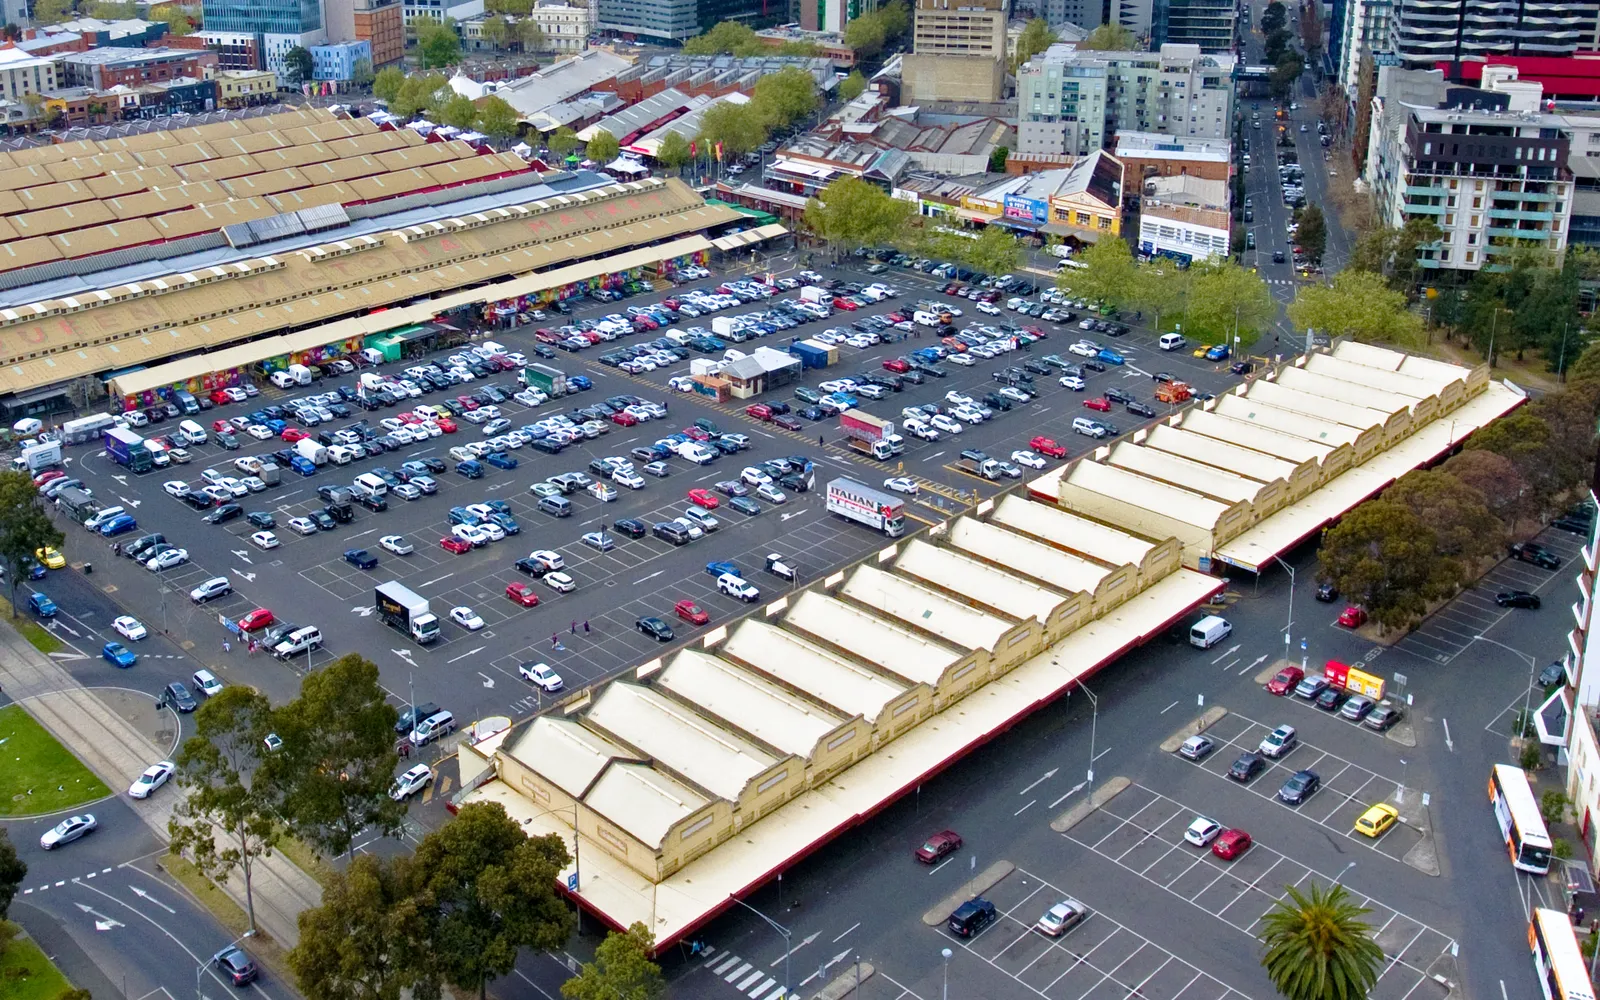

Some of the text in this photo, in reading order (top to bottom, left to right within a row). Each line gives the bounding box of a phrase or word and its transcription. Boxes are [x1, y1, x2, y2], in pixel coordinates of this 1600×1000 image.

[528, 194, 663, 234] MARKET
[831, 486, 875, 509] ITALIAN
[1364, 645, 1387, 662] KEEP
